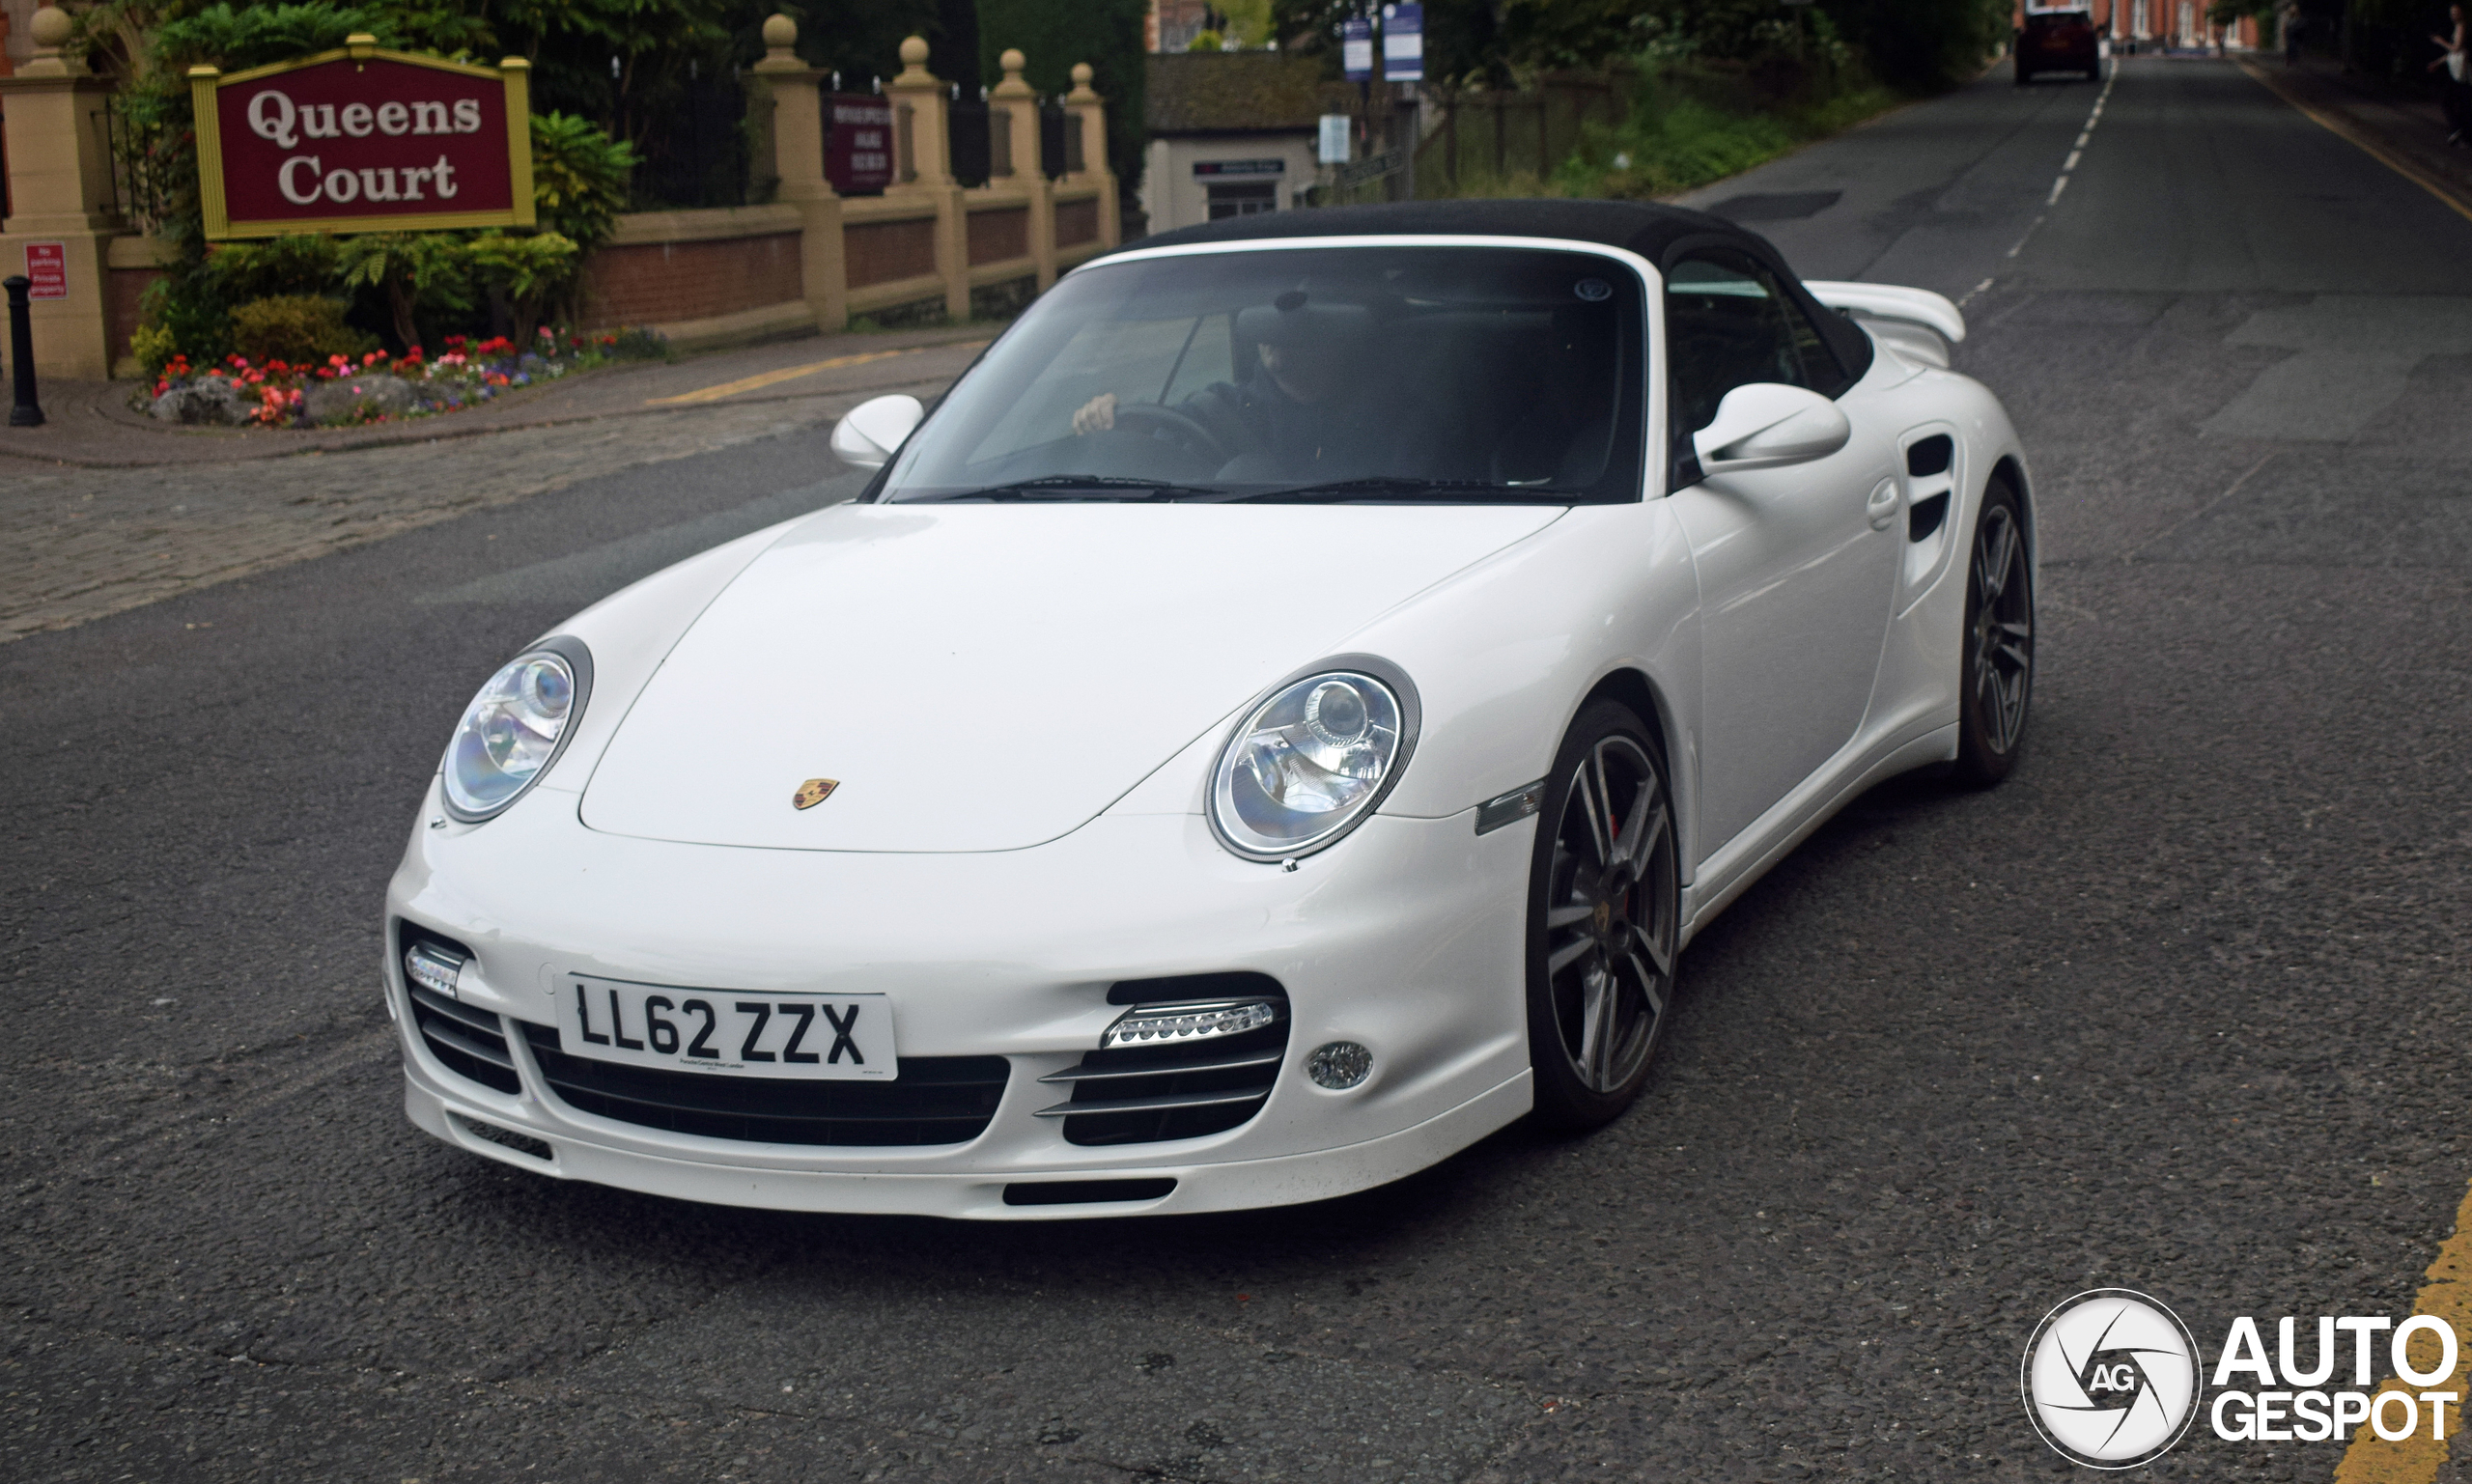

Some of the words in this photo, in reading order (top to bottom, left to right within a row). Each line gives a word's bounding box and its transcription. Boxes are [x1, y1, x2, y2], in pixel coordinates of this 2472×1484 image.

[247, 89, 482, 150] Queens
[278, 154, 459, 206] Court
[39, 247, 51, 257] No
[30, 258, 62, 268] parking
[32, 273, 62, 283] Private
[30, 284, 66, 295] property
[576, 983, 720, 1060] LL62
[734, 1000, 865, 1066] ZZX
